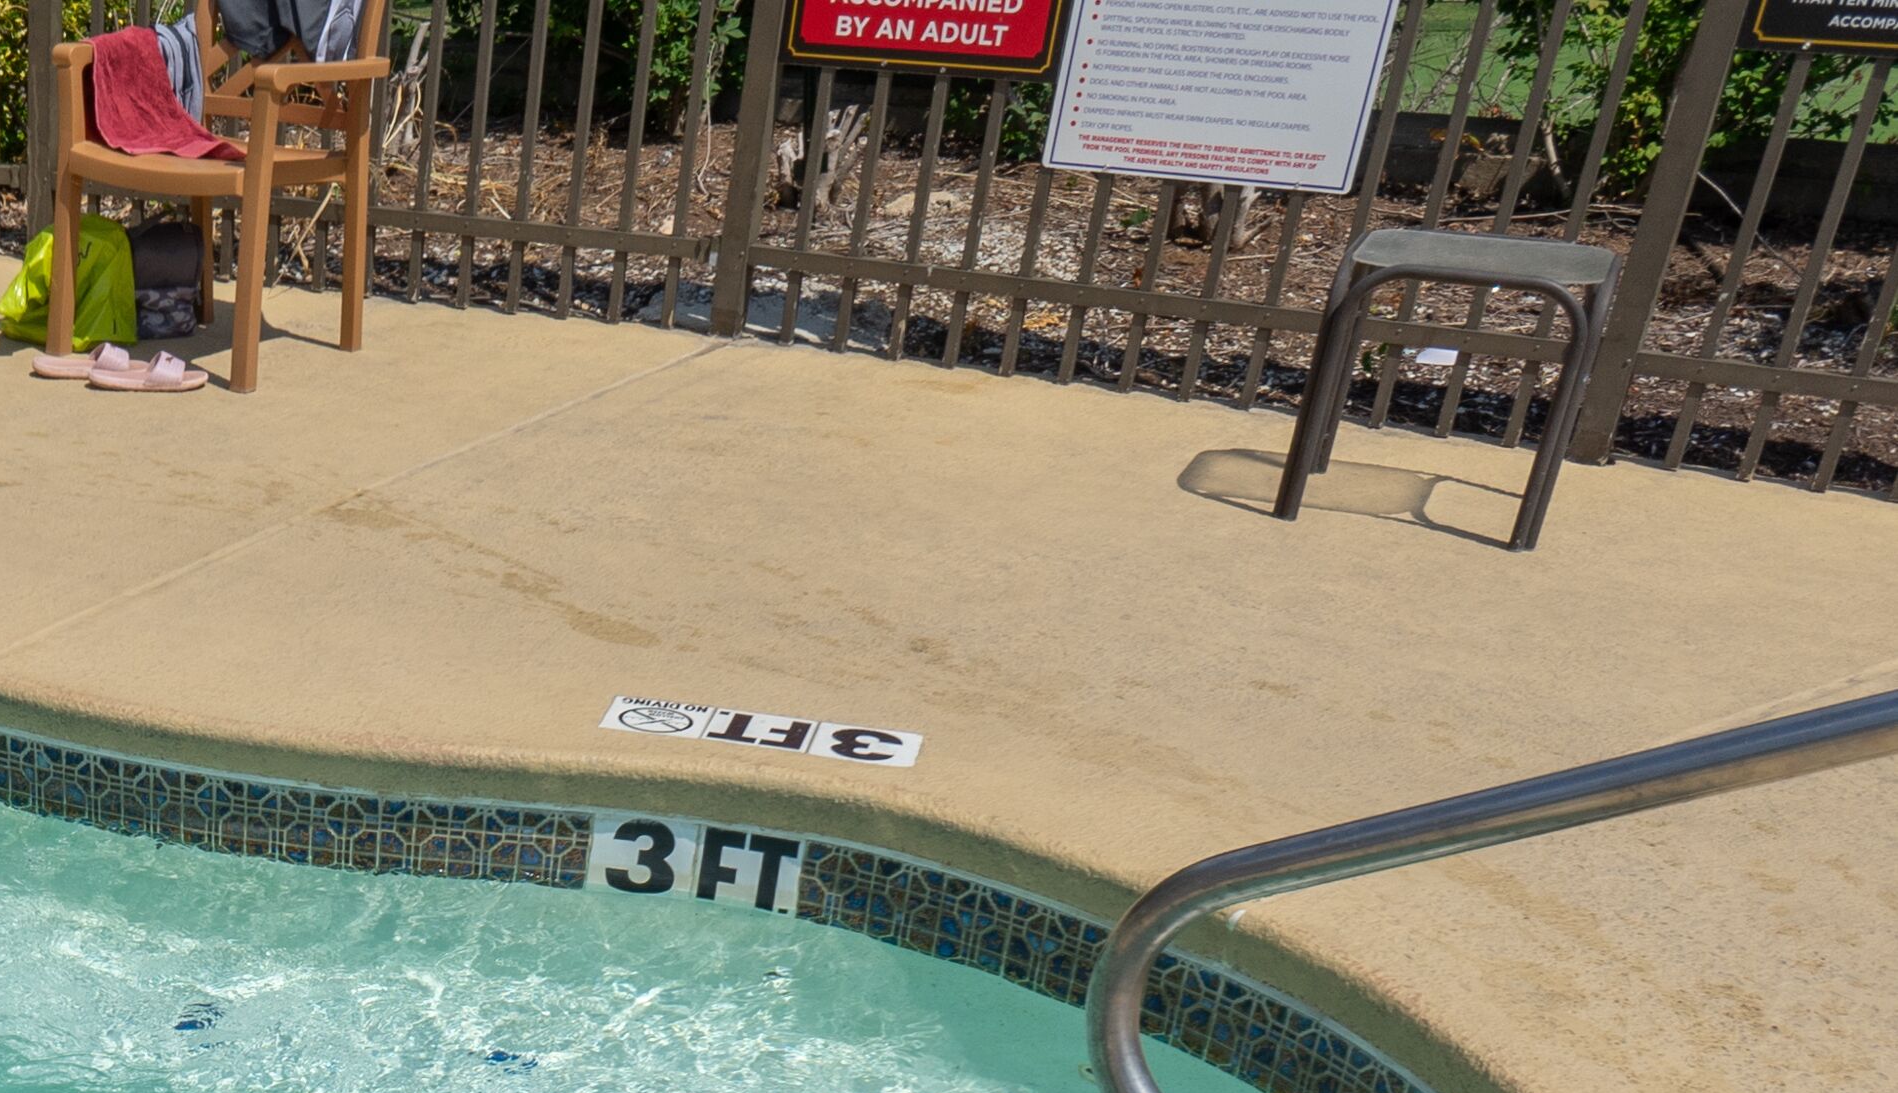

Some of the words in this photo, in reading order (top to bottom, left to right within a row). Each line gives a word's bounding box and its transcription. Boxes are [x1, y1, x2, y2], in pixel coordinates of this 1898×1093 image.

[829, 0, 1024, 14] PANIED
[1137, 2, 1162, 10] HAVING
[1163, 3, 1183, 11] OPEN
[1184, 4, 1215, 14] BLISTERS,
[1216, 6, 1237, 15] CUTS,
[1237, 8, 1253, 16] ETC.,
[1270, 10, 1300, 18] ADVISED
[1300, 11, 1317, 19] NOT
[1317, 12, 1328, 20] TO
[1328, 13, 1342, 21] USE
[1358, 15, 1380, 23] POOL.
[835, 15, 871, 38] BY
[874, 18, 915, 41] AN
[920, 21, 1010, 47] ADULT
[1101, 24, 1123, 32] WASTE
[1132, 26, 1146, 34] THE
[1146, 27, 1164, 35] POOL
[1172, 29, 1203, 38] STRICTLY
[1204, 31, 1246, 40] PROHIBITED.
[1102, 14, 1134, 24] SPITTING,
[1135, 16, 1169, 25] SPOUTING
[1170, 19, 1195, 28] WATER,
[1195, 20, 1228, 29] BLOWING
[1228, 22, 1241, 30] THE
[1243, 23, 1261, 31] NOSE
[1274, 25, 1324, 35] DISCHARGING
[1324, 29, 1350, 37] BODILY
[1102, 49, 1141, 59] FORBIDDEN
[1183, 55, 1202, 63] AREA,
[1205, 56, 1238, 65] SHOWERS
[1250, 60, 1285, 69] DRESSING
[1285, 62, 1313, 70] ROOMS.
[1109, 40, 1142, 49] RUNNING,
[1155, 43, 1179, 52] DIVING,
[1181, 45, 1223, 54] BOISTEROUS
[1235, 48, 1262, 57] ROUGH
[1262, 50, 1279, 58] PLAY
[1280, 51, 1291, 59] OR
[1292, 52, 1328, 61] EXCESSIVE
[1328, 55, 1351, 63] NOISE
[1092, 63, 1104, 71] NO
[1104, 64, 1130, 73] PERSON
[1131, 66, 1146, 74] MAY
[1147, 67, 1163, 75] TAKE
[1164, 69, 1186, 77] GLASS
[1186, 70, 1208, 78] INSIDE
[1223, 73, 1242, 81] POOL
[1243, 74, 1289, 84] ENCLOSURES.
[1086, 92, 1098, 100] NO
[1098, 93, 1130, 102] SMOKING
[1138, 96, 1157, 104] POOL
[1158, 98, 1177, 106] AREA.
[1089, 78, 1110, 86] DOGS
[1110, 79, 1125, 87] AND
[1126, 81, 1148, 89] OTHER
[1149, 82, 1179, 91] ANIMALS
[1210, 87, 1244, 96] ALLOWED
[1252, 90, 1267, 98] THE
[1267, 91, 1287, 99] POOL
[1288, 93, 1307, 101] AREA.
[1080, 121, 1096, 129] STAY
[1097, 122, 1110, 130] OFF
[1111, 123, 1134, 132] ROPES.
[1083, 107, 1116, 116] DIAPERED
[1116, 109, 1144, 118] INFANTS
[1145, 112, 1164, 120] MUST
[1165, 113, 1184, 121] WEAR
[1185, 115, 1204, 123] SWIM
[1205, 116, 1235, 125] DIAPERS.
[1248, 120, 1280, 129] REGULAR
[1280, 122, 1311, 131] DIAPERS.
[1078, 133, 1091, 141] THE
[1092, 135, 1134, 145] MANAGEMENT
[1135, 138, 1168, 148] RESERVES
[1169, 141, 1181, 149] THE
[1183, 142, 1203, 151] RIGHT
[1204, 144, 1212, 152] TO
[1214, 145, 1238, 154] REFUSE
[1240, 147, 1280, 157] ADMITTANCE
[1282, 151, 1293, 159] TO,
[1305, 153, 1326, 161] EJECT
[1082, 143, 1100, 151] FROM
[1101, 145, 1113, 153] THE
[1114, 146, 1131, 154] POOL
[1132, 148, 1164, 158] PREMISES,
[1180, 152, 1210, 161] PERSONS
[1210, 154, 1235, 163] FAILING
[1247, 158, 1273, 166] COMPLY
[1274, 160, 1291, 168] WITH
[1123, 156, 1136, 164] THE
[1136, 157, 1157, 166] ABOVE
[1158, 159, 1184, 168] HEALTH
[1199, 163, 1223, 171] SAFETY
[1224, 165, 1270, 175] REGULATIONS
[622, 697, 681, 710] DIVING
[683, 703, 709, 713] NO
[706, 710, 813, 751] FT.
[830, 728, 903, 761] 3
[605, 818, 676, 894] 3
[696, 826, 801, 915] FT.
